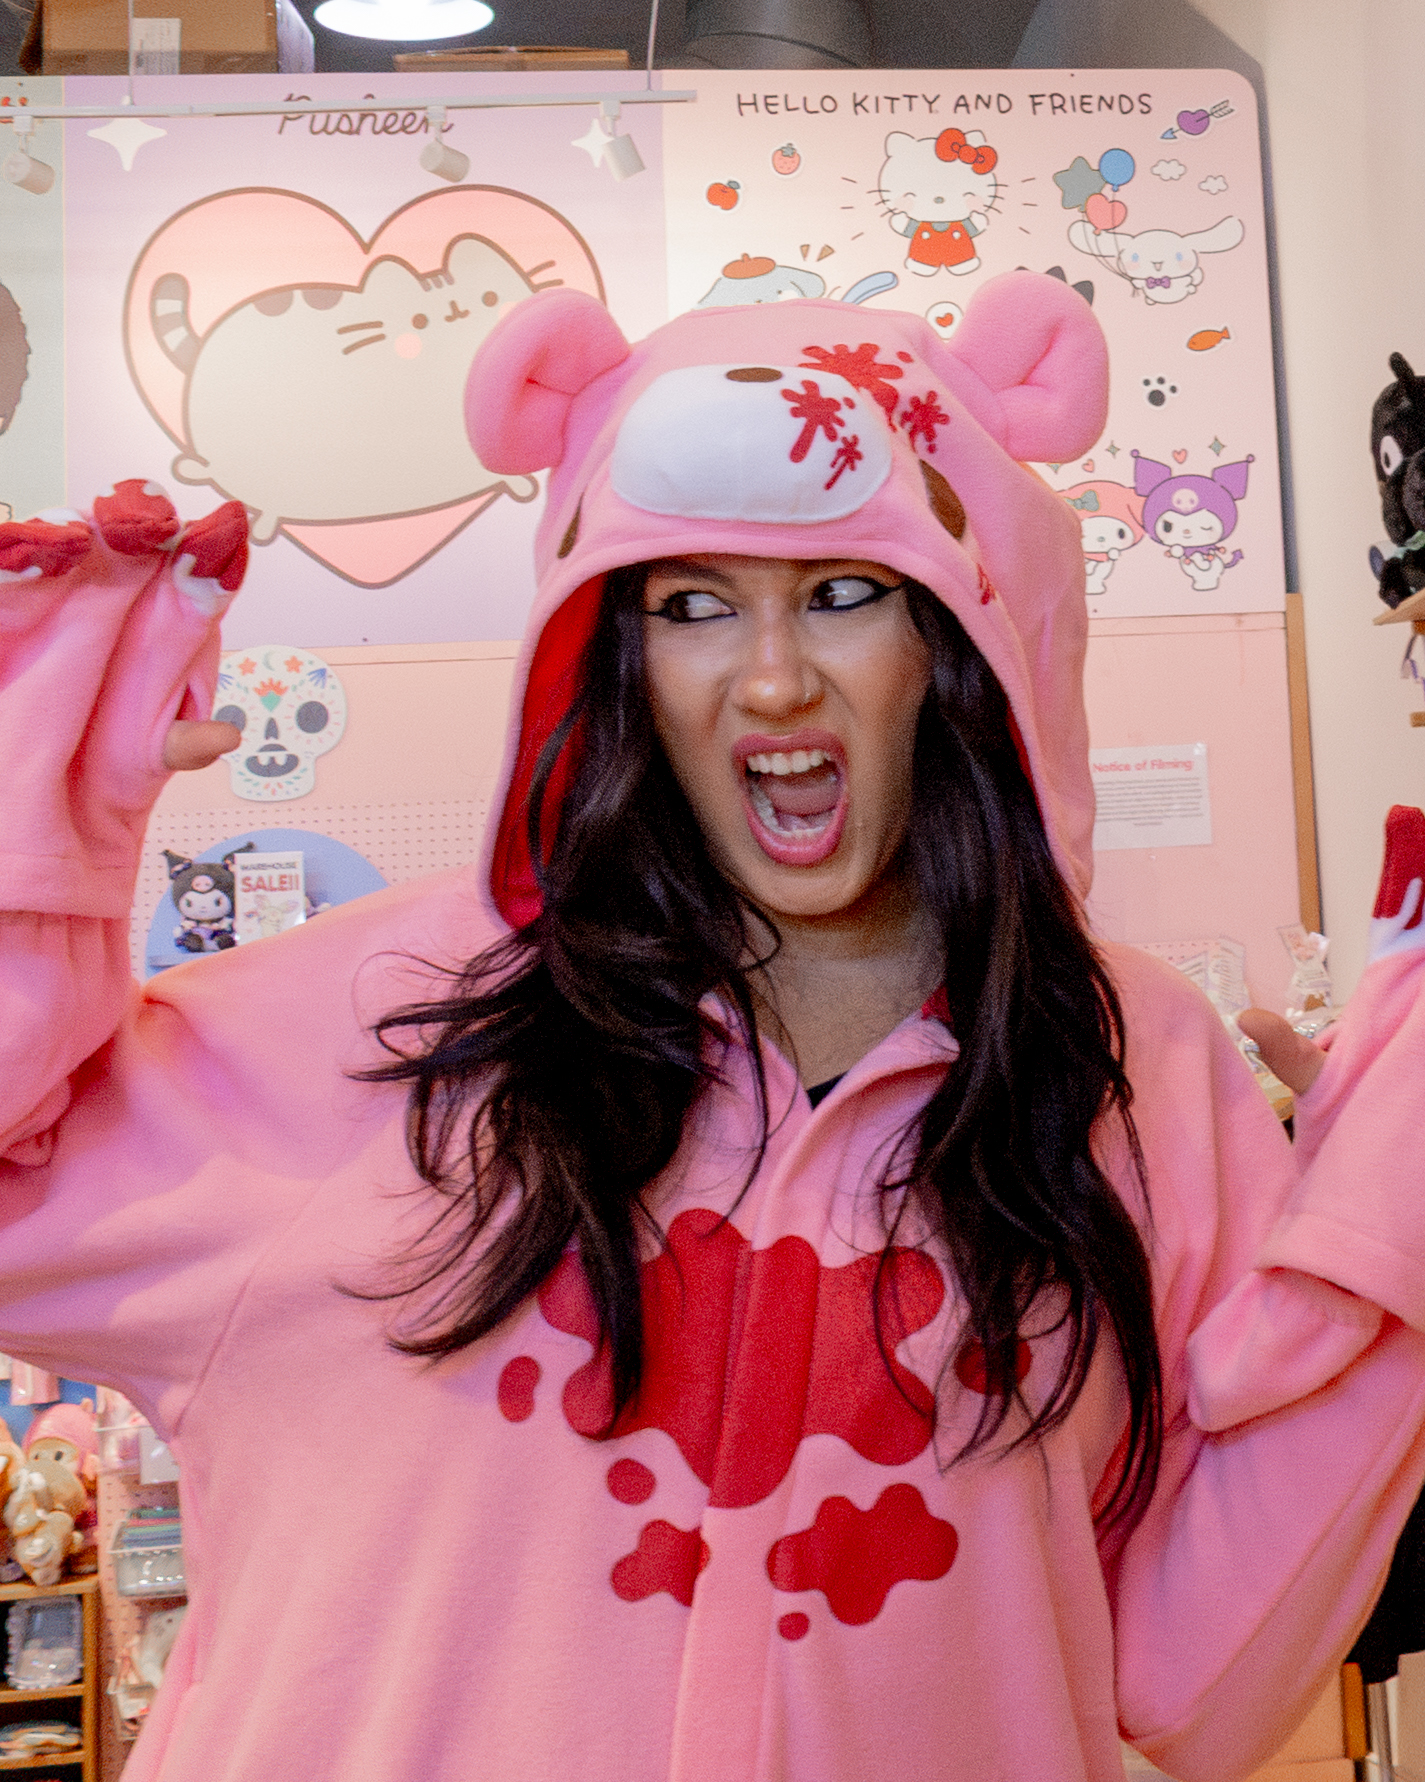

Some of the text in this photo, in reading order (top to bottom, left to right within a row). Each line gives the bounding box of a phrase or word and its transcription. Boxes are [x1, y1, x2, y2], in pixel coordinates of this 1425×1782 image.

[737, 92, 1153, 116] HELLO KITTY AND FRIENDS
[1093, 759, 1194, 773] Notice of Filming
